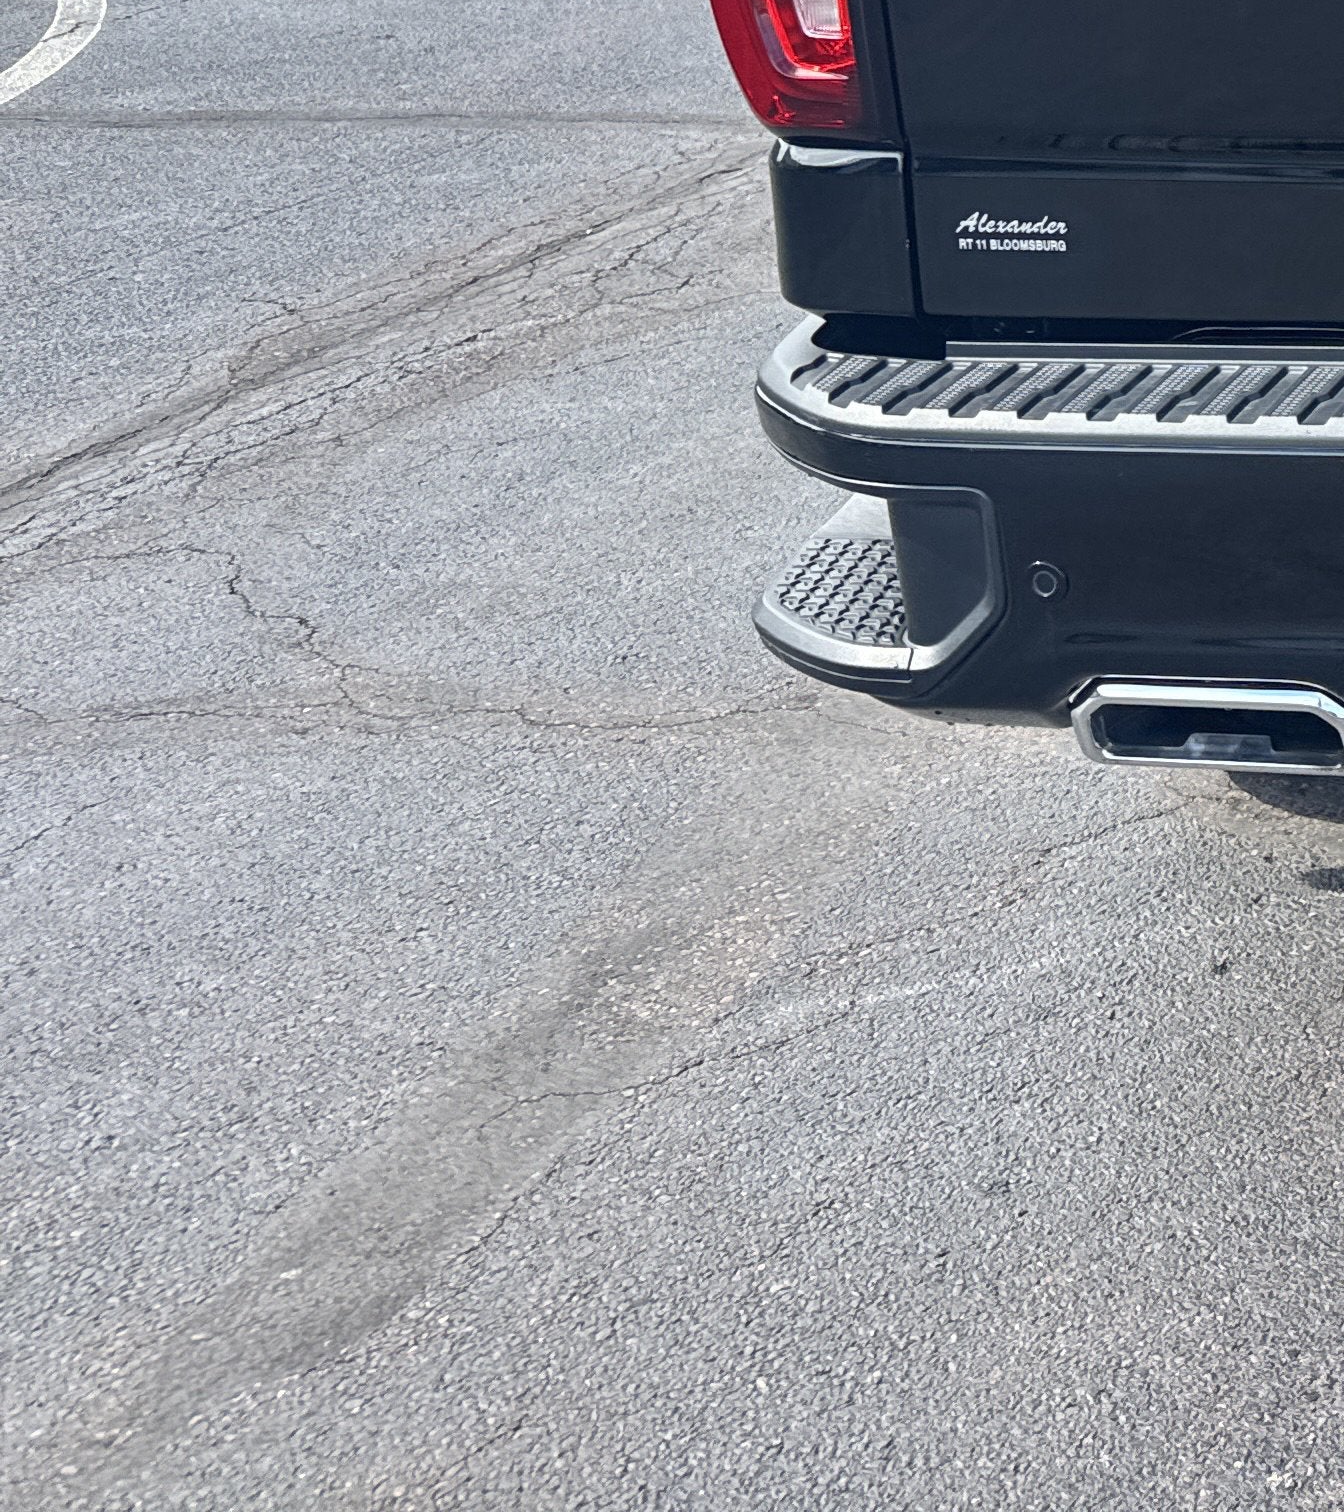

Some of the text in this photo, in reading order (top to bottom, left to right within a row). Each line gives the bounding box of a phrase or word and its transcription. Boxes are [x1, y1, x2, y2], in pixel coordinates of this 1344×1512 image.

[955, 211, 1068, 235] Alexander
[958, 238, 1067, 252] RT 11 BLOOMSBURG
